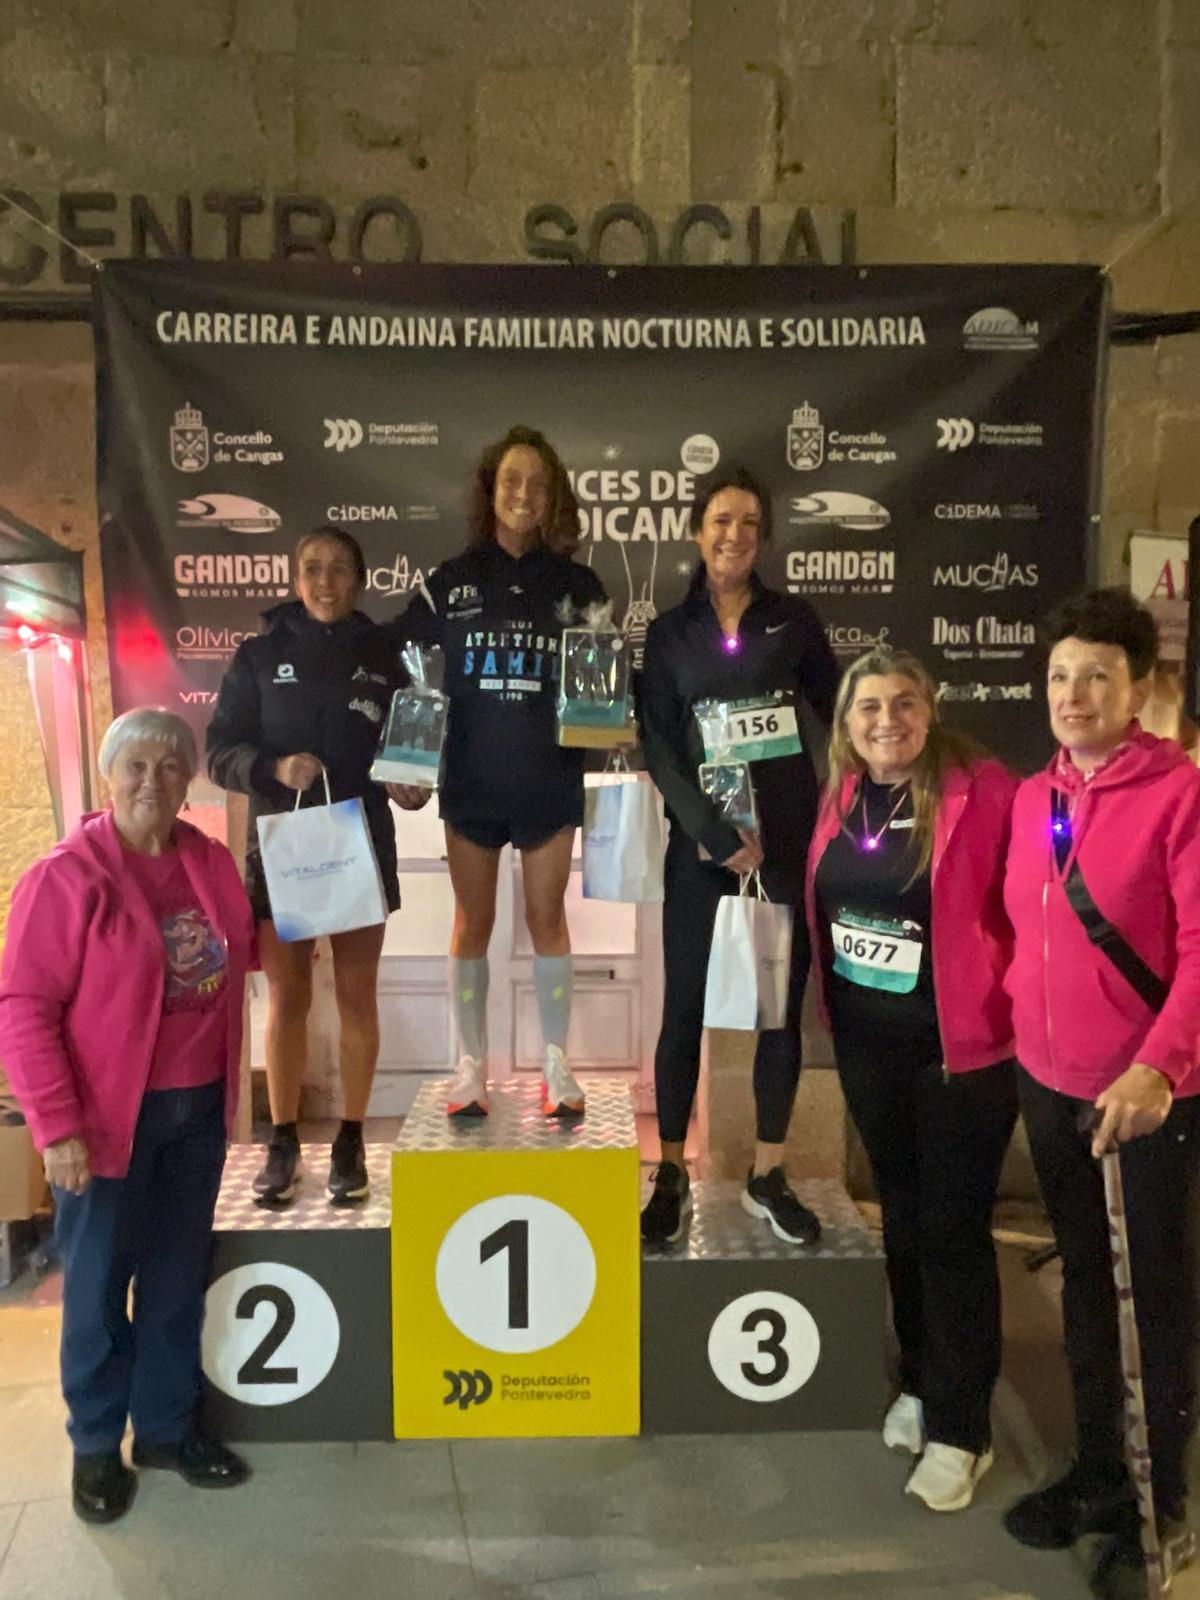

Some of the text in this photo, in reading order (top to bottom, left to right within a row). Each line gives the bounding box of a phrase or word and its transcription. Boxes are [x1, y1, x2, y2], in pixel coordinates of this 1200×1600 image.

[156, 310, 926, 348] CARREIRA E ANDAINA FAMILIAR NOCTURNA E SOLIDARIA
[213, 431, 273, 445] Concello
[828, 431, 887, 445] Concello
[214, 449, 284, 465] de Cangas
[827, 448, 897, 464] de Cangas
[567, 470, 696, 501] CES DE
[933, 552, 1039, 592] MUCHAS
[932, 616, 1036, 646] Dos Chata
[843, 934, 899, 964] 0677
[479, 1219, 529, 1329] 1
[235, 1284, 298, 1385] 2
[740, 1308, 790, 1387] 3
[501, 1372, 591, 1389] Deputación
[501, 1388, 592, 1402] Pontevedra
